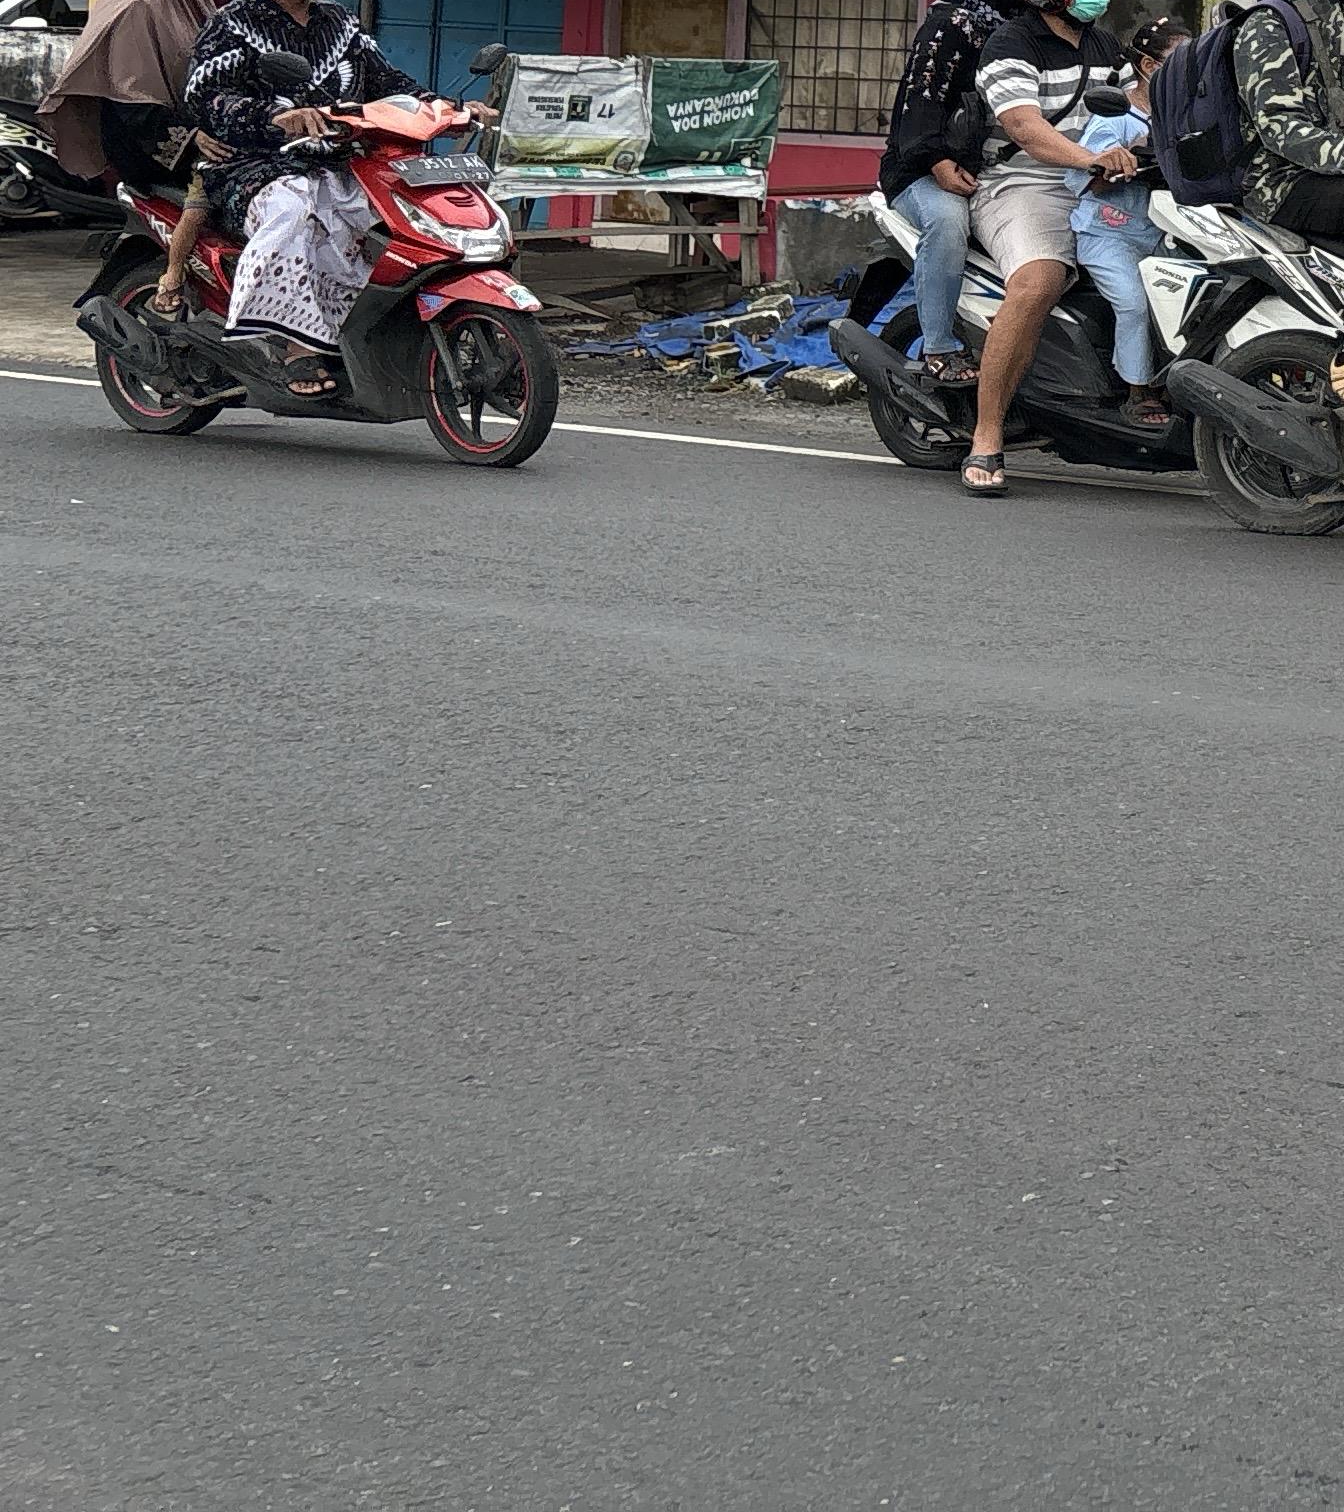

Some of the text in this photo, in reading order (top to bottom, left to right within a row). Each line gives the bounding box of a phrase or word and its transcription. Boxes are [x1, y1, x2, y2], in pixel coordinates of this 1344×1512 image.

[597, 101, 616, 120] 17
[703, 102, 755, 129] MOHON
[671, 117, 700, 134] DOA
[397, 161, 409, 172] W
[419, 157, 458, 171] 3512
[463, 154, 486, 168] AK
[1154, 265, 1188, 283] HONDA
